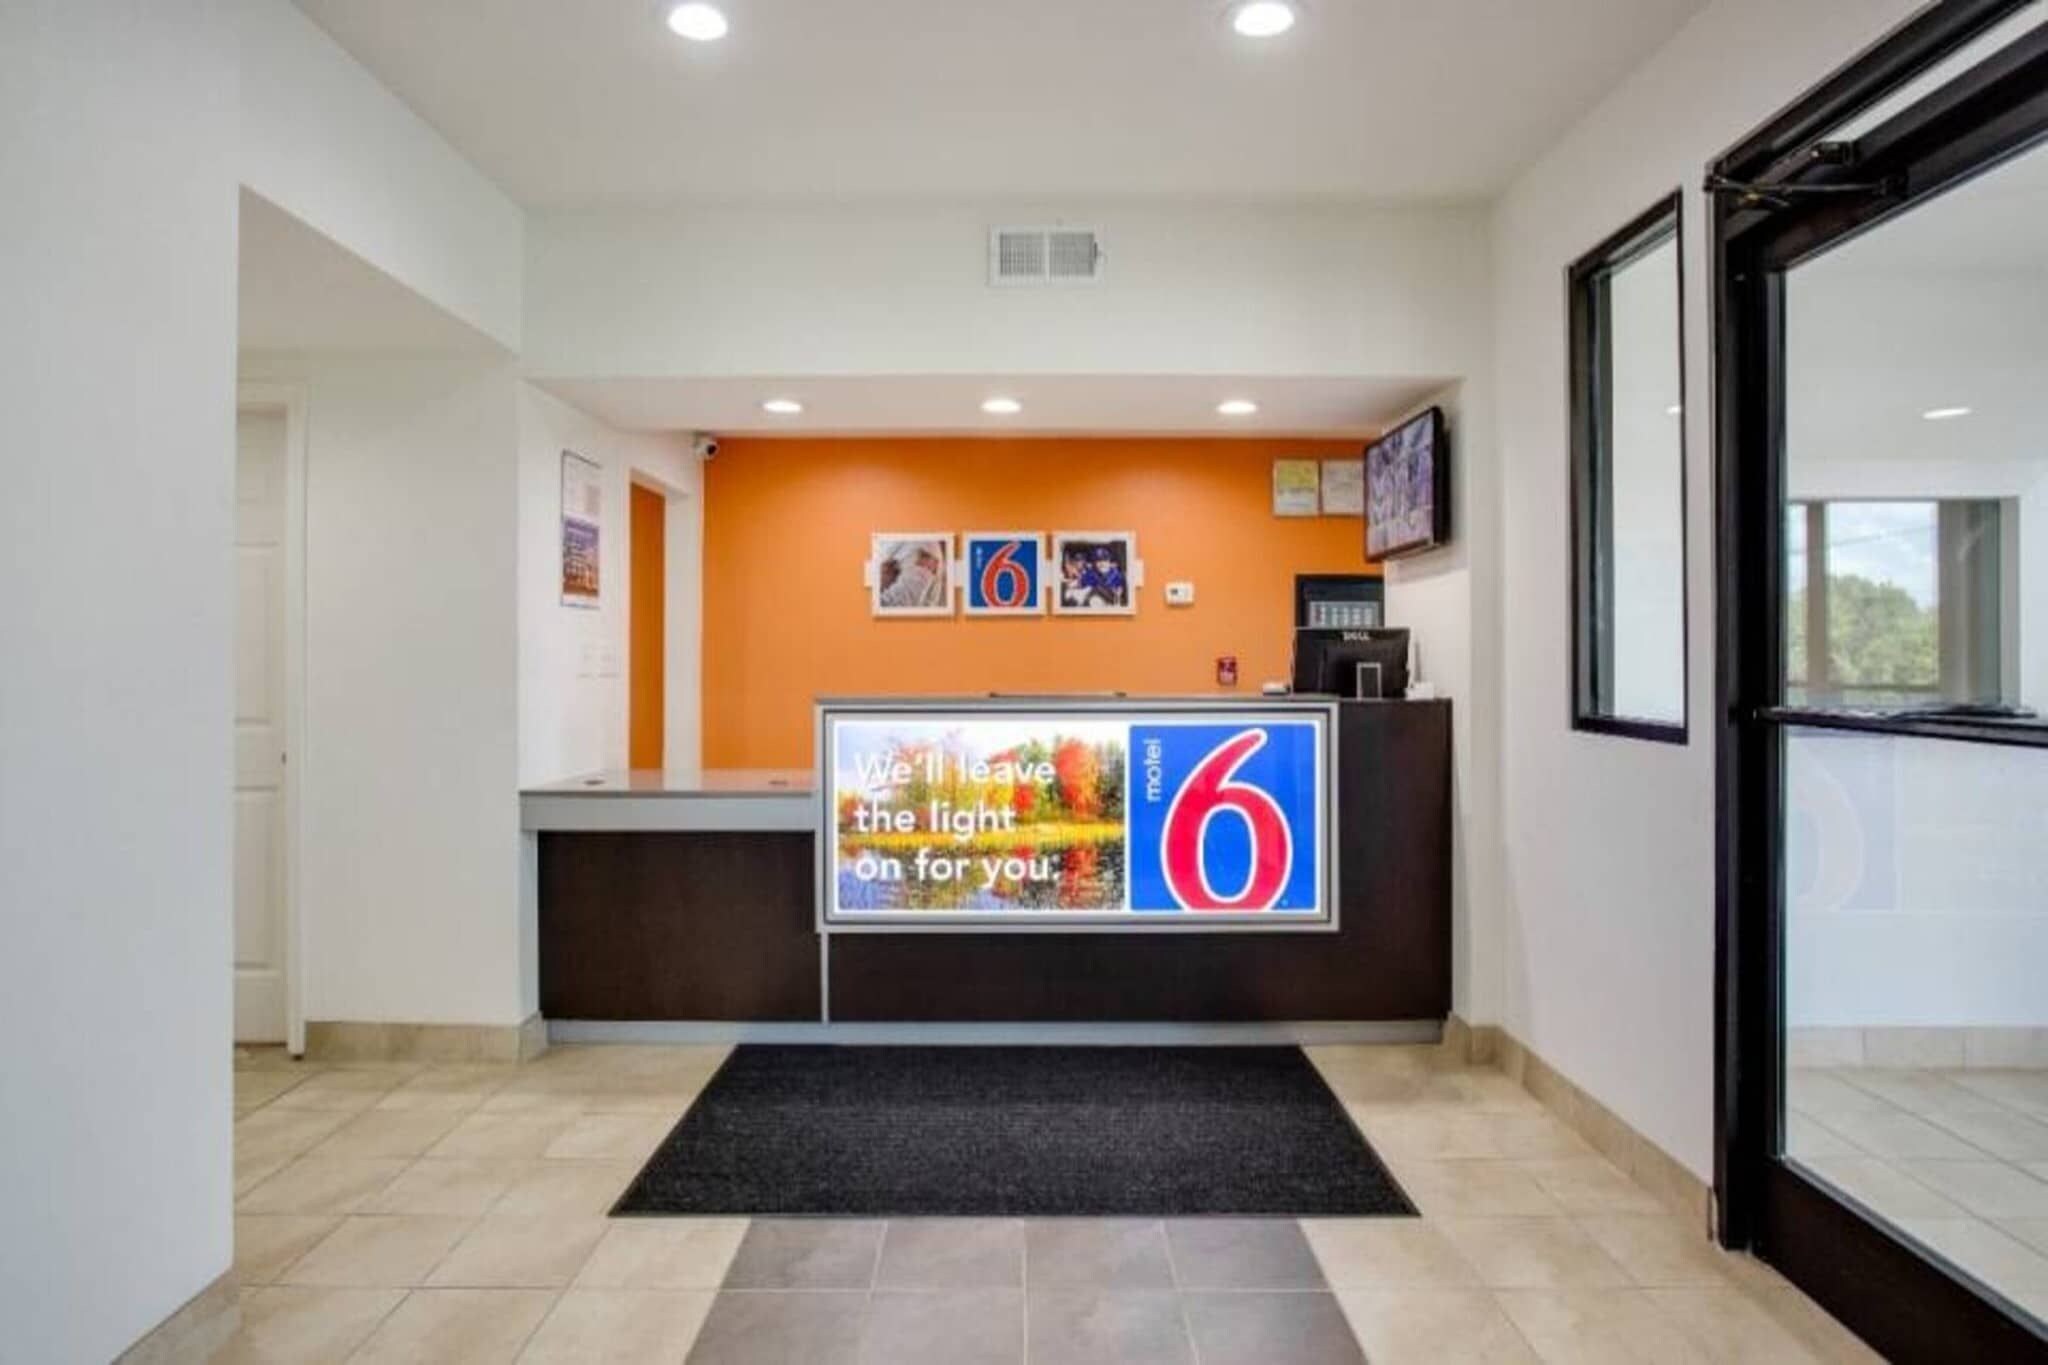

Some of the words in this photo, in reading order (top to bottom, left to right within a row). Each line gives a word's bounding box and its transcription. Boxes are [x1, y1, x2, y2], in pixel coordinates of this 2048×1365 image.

[981, 540, 1030, 608] 6
[1343, 631, 1370, 641] DELL
[854, 751, 945, 785] We'll
[959, 751, 1056, 785] leave
[1143, 739, 1162, 802] motel
[853, 800, 916, 833] the
[930, 800, 1016, 840] light
[1160, 728, 1294, 913] 6
[855, 857, 901, 881] on
[915, 848, 970, 881] for
